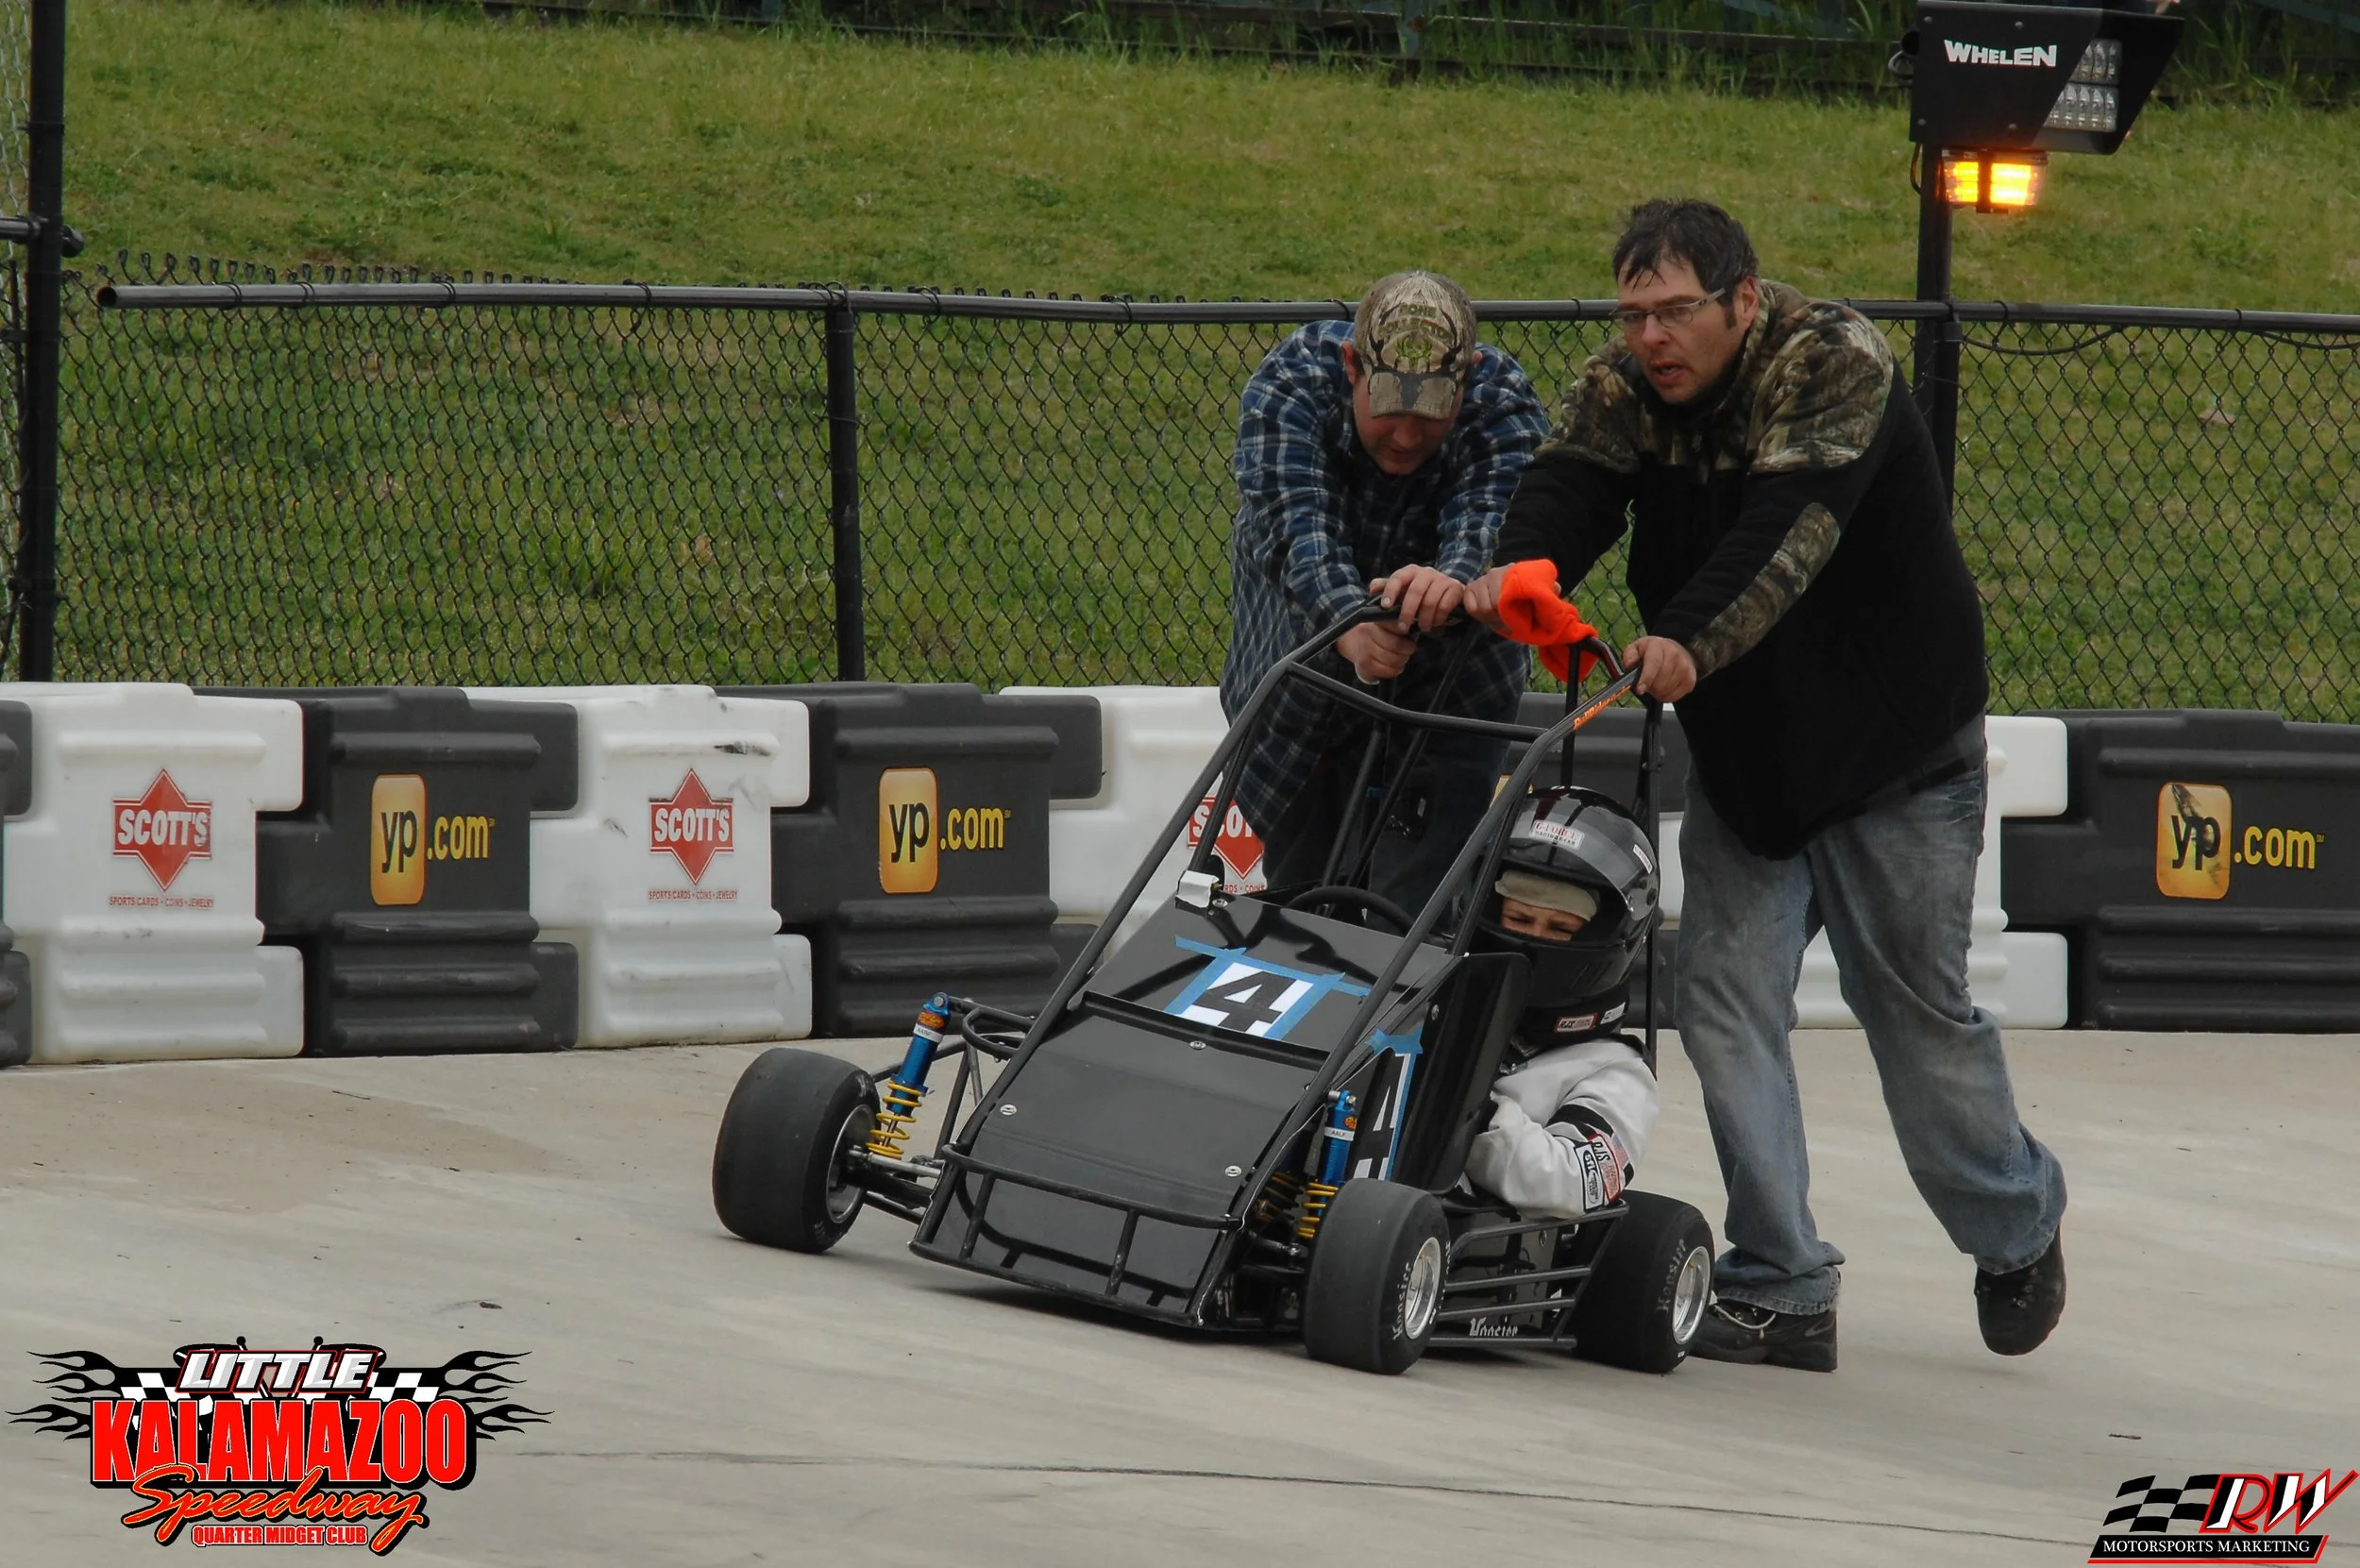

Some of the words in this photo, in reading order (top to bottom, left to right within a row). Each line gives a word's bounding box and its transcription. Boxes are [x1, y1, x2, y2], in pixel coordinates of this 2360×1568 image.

[1945, 39, 2057, 67] WHELEN
[117, 808, 208, 847] SCOTT'S
[653, 807, 731, 843] SCOTT'S
[109, 896, 135, 906] SPORTS
[137, 897, 159, 907] CARDS
[649, 890, 671, 900] SPORTS
[672, 890, 691, 900] CARDS
[1192, 970, 1282, 1033] 4
